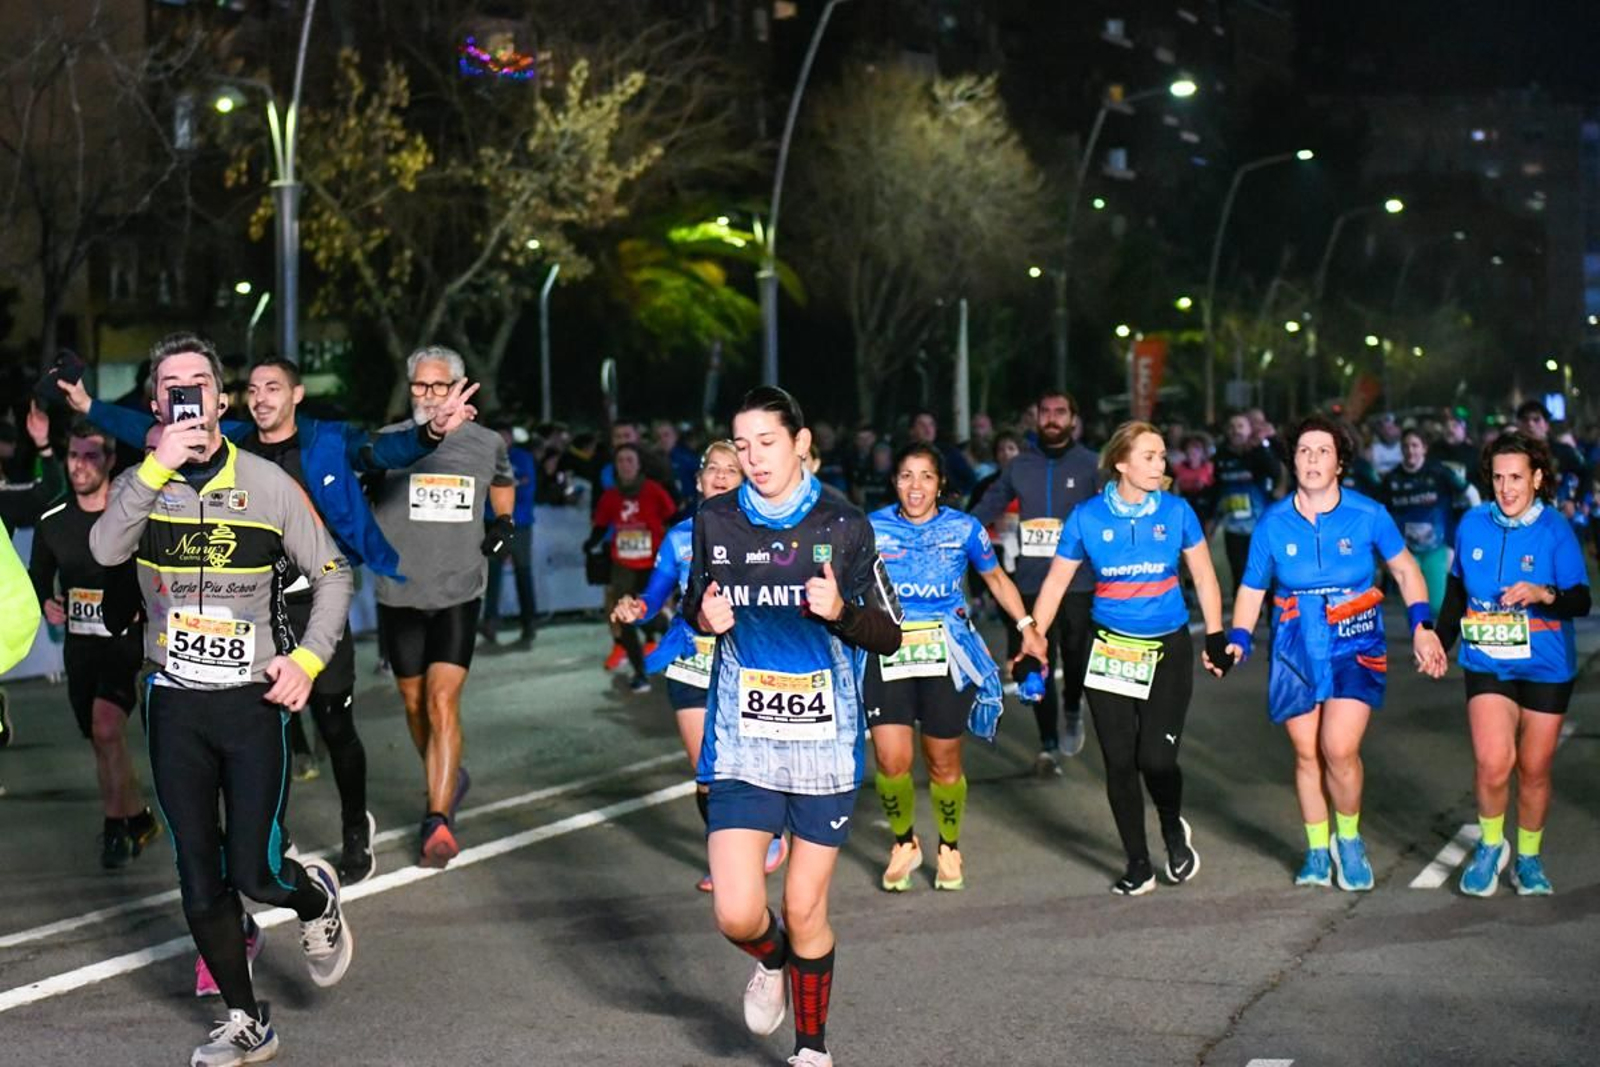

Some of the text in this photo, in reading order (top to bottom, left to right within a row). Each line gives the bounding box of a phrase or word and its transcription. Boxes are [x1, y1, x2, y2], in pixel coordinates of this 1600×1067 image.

[1101, 562, 1166, 577] enerplus
[1468, 624, 1524, 641] 1284
[174, 630, 245, 660] 5458
[747, 690, 826, 716] 8464
